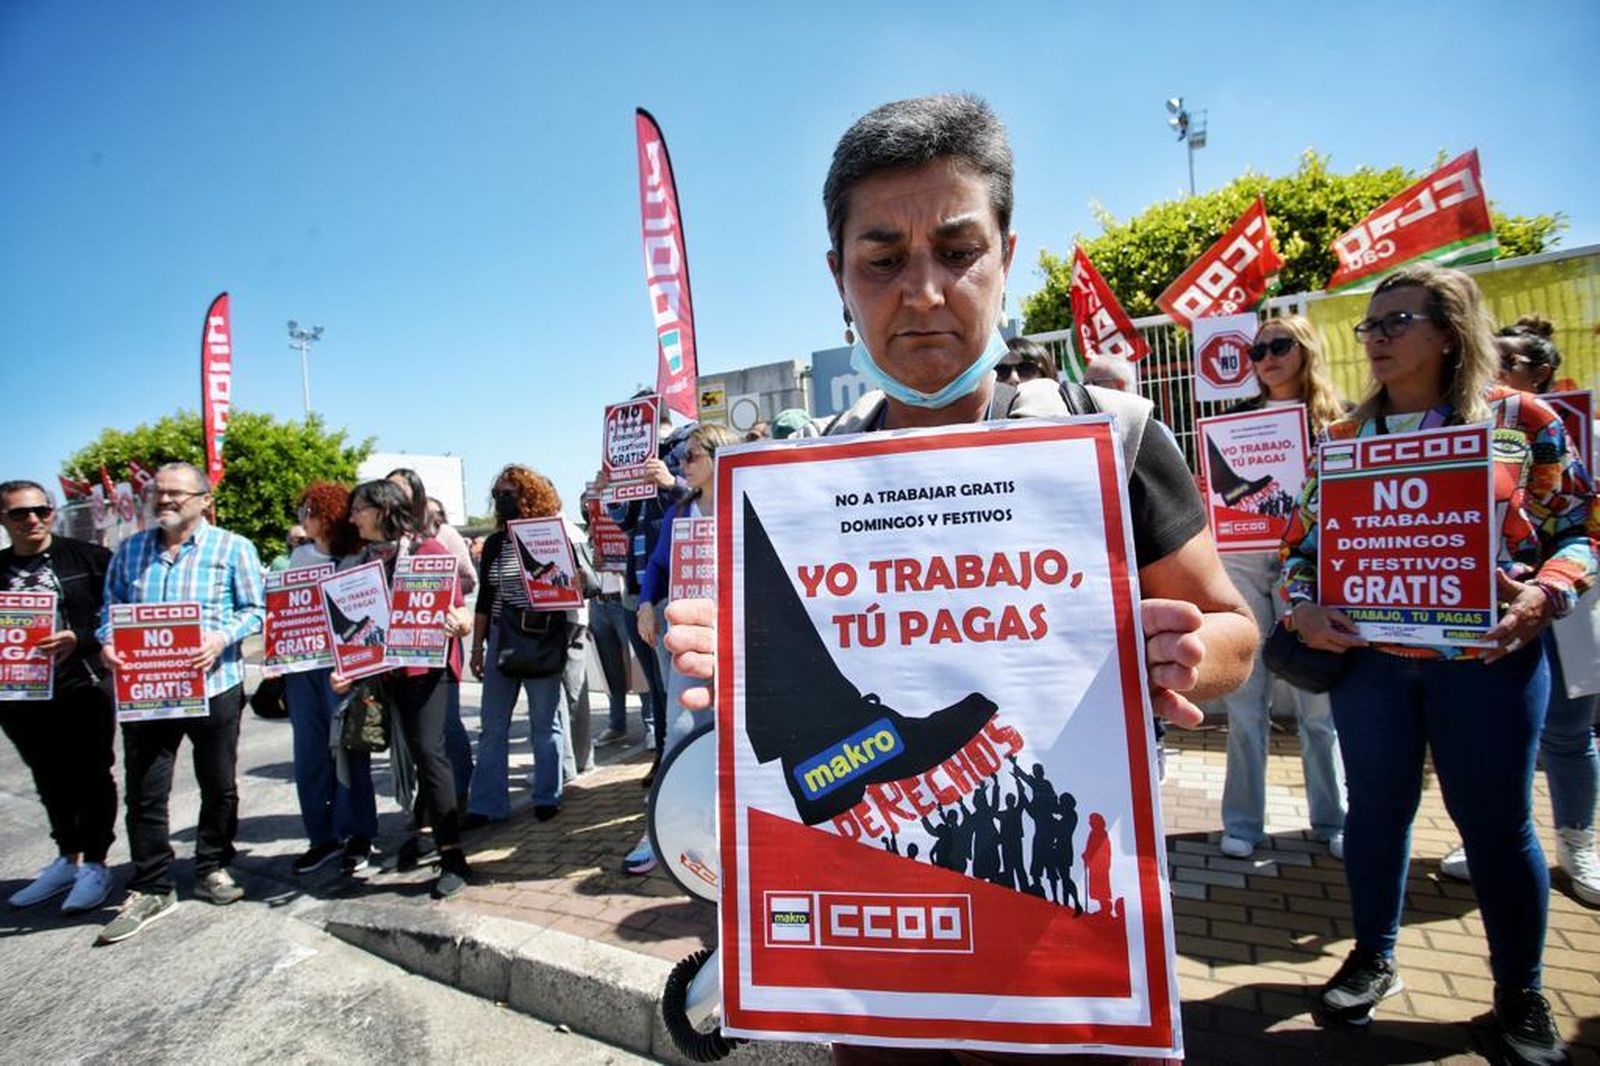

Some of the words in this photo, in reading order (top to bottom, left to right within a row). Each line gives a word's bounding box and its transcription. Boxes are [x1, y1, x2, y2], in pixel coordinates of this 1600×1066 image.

[1221, 356, 1239, 370] NO
[620, 406, 640, 420] NO
[1221, 445, 1237, 456] YO
[1369, 435, 1480, 463] CCOO
[612, 451, 646, 466] GRATIS
[1248, 454, 1286, 466] PAGAS
[618, 484, 653, 497] CCOO
[835, 493, 858, 507] NO
[863, 492, 874, 505] A
[878, 485, 956, 503] TRABAJAR
[960, 481, 1015, 496] GRATIS
[1373, 478, 1428, 511] NO
[841, 514, 924, 533] DOMINGOS
[927, 513, 938, 526] Y
[943, 509, 1013, 525] FESTIVOS
[1234, 521, 1266, 532] CCOO
[1325, 518, 1340, 530] A
[1352, 511, 1481, 529] TRABAJAR
[1338, 534, 1465, 550] DOMINGOS
[415, 560, 454, 571] CCOO
[1331, 559, 1345, 571] Y
[1358, 557, 1476, 571] FESTIVOS
[287, 568, 331, 583] CCOO
[798, 562, 858, 598] YO
[869, 549, 1083, 593] TRABAJO,
[289, 589, 312, 607] NO
[1343, 575, 1462, 606] GRATIS
[409, 591, 435, 608] NO
[139, 607, 197, 620] CCOO
[1437, 612, 1482, 625] PAGAS
[832, 602, 887, 648] TÚ
[899, 603, 1049, 646] PAGAS
[144, 628, 174, 647] NO
[275, 635, 326, 656] GRATIS
[118, 650, 127, 658] A
[122, 675, 130, 683] Y
[130, 681, 193, 700] GRATIS
[804, 730, 895, 792] makro
[832, 713, 1024, 841] DERECHOS
[774, 911, 807, 924] makro
[830, 904, 962, 940] CCOO
